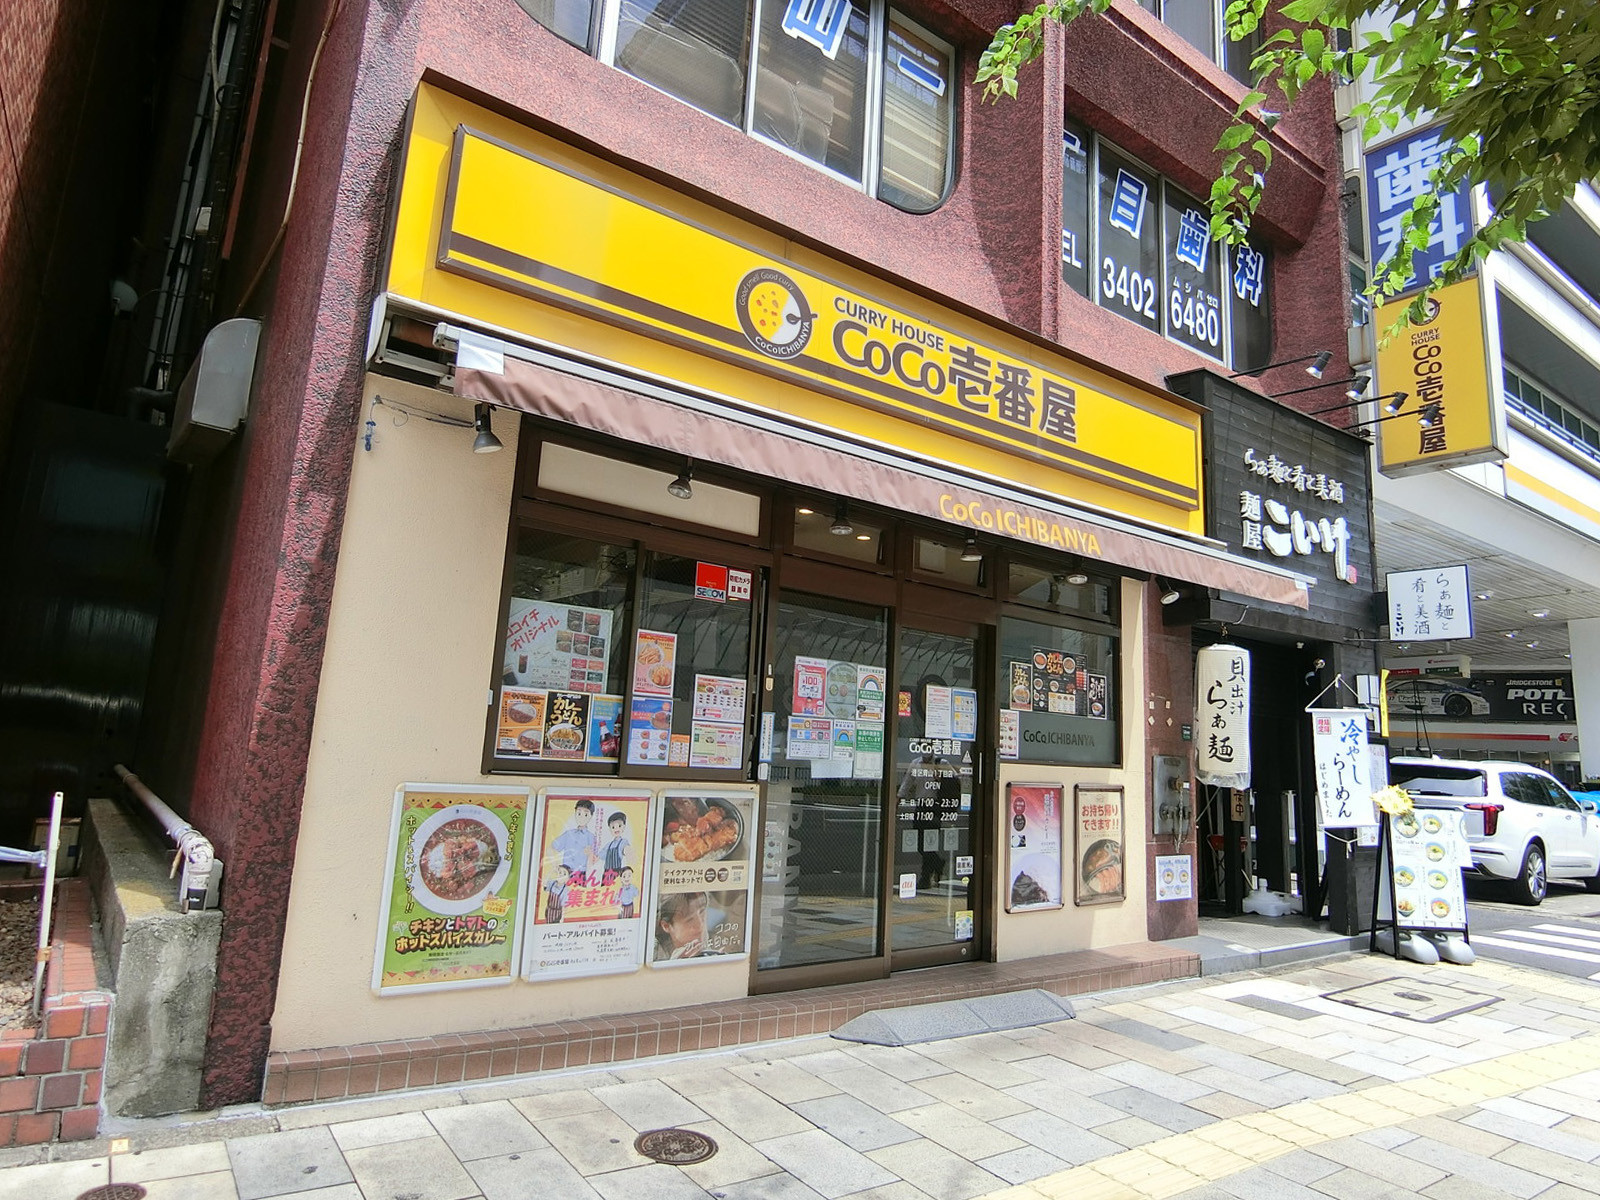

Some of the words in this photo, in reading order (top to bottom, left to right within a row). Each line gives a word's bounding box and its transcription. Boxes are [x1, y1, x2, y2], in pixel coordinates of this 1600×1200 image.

[1102, 256, 1156, 320] 3402
[1170, 289, 1219, 347] 6480
[833, 296, 888, 330] CURRY
[891, 318, 945, 353] HOUSE
[1411, 327, 1440, 340] CURRY
[1411, 333, 1440, 346] HOUSE
[832, 319, 1078, 443] CoCo壱番屋
[1243, 447, 1344, 504] らぁ麺と肴と美酒
[1239, 490, 1263, 551] 麺屋
[1263, 498, 1351, 581] こいけ
[696, 586, 725, 600] SECOM
[1434, 572, 1455, 632] らぁ麺と
[1411, 576, 1431, 636] 肴と美酒
[510, 614, 560, 651] オリジナル
[1227, 655, 1247, 717] 貝出汁
[1506, 679, 1554, 687] BRIDGESTONE
[550, 709, 583, 725] うどん
[553, 698, 583, 712] カレー
[1206, 679, 1235, 764] らぁ麺
[909, 739, 961, 756] CoCo壱番屋
[1340, 718, 1363, 786] 冷やし
[924, 781, 942, 791] OPEN
[1333, 753, 1352, 819] らーめん
[1081, 803, 1119, 817] お持ち帰り
[566, 868, 619, 888] みんな
[664, 868, 704, 877] テイクアウトは
[564, 886, 624, 909] 集まれ!
[409, 914, 498, 936] チキンとトマトの
[395, 930, 507, 954] ホットスパイスカレー
